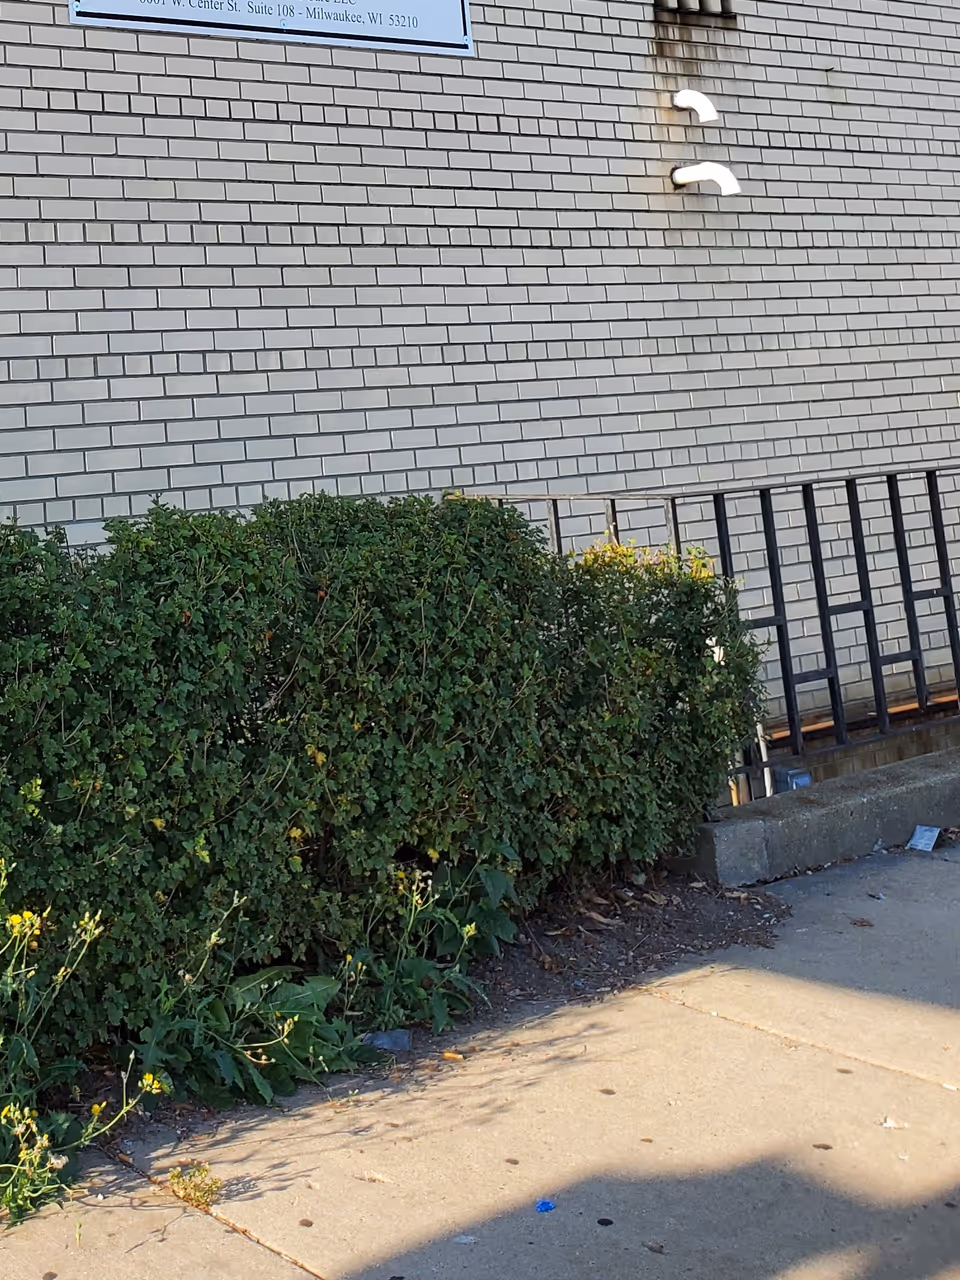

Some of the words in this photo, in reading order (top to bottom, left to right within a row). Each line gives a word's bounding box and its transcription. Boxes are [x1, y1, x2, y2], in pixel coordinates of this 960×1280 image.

[227, 0, 241, 12] St.
[247, 0, 273, 15] Suite
[277, 3, 295, 18] 108
[306, 6, 365, 25] Milwaukee,
[367, 11, 383, 26] WI
[389, 14, 419, 28] 53210
